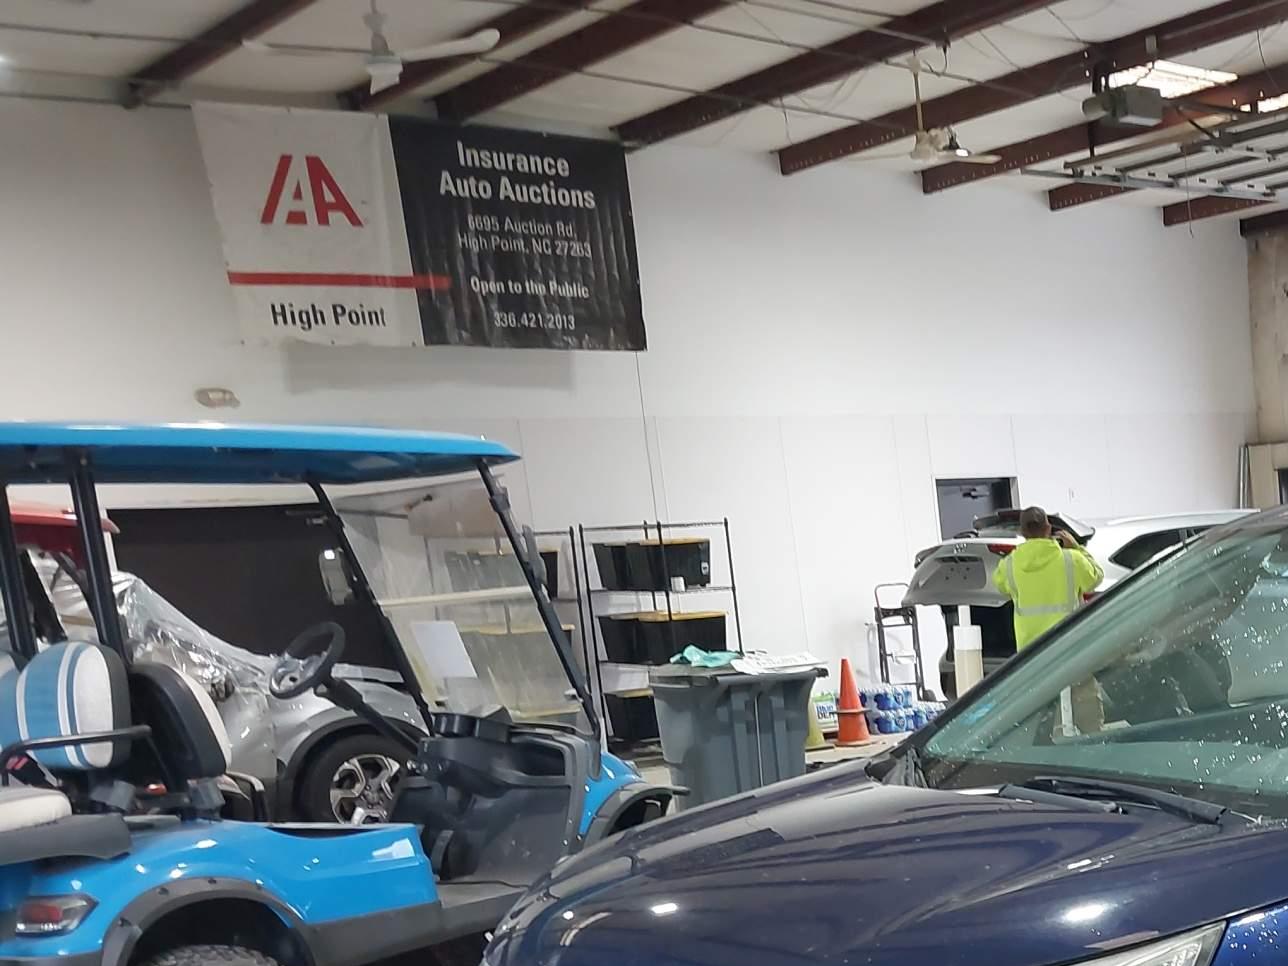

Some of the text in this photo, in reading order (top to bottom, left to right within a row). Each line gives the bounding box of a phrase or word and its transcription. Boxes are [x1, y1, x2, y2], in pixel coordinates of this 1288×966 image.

[457, 140, 570, 177] Insurance
[440, 170, 596, 209] Auto Auctions
[504, 216, 552, 237] Auction
[458, 232, 488, 253] High
[470, 275, 590, 299] Open to the Public
[271, 302, 386, 331] High Point
